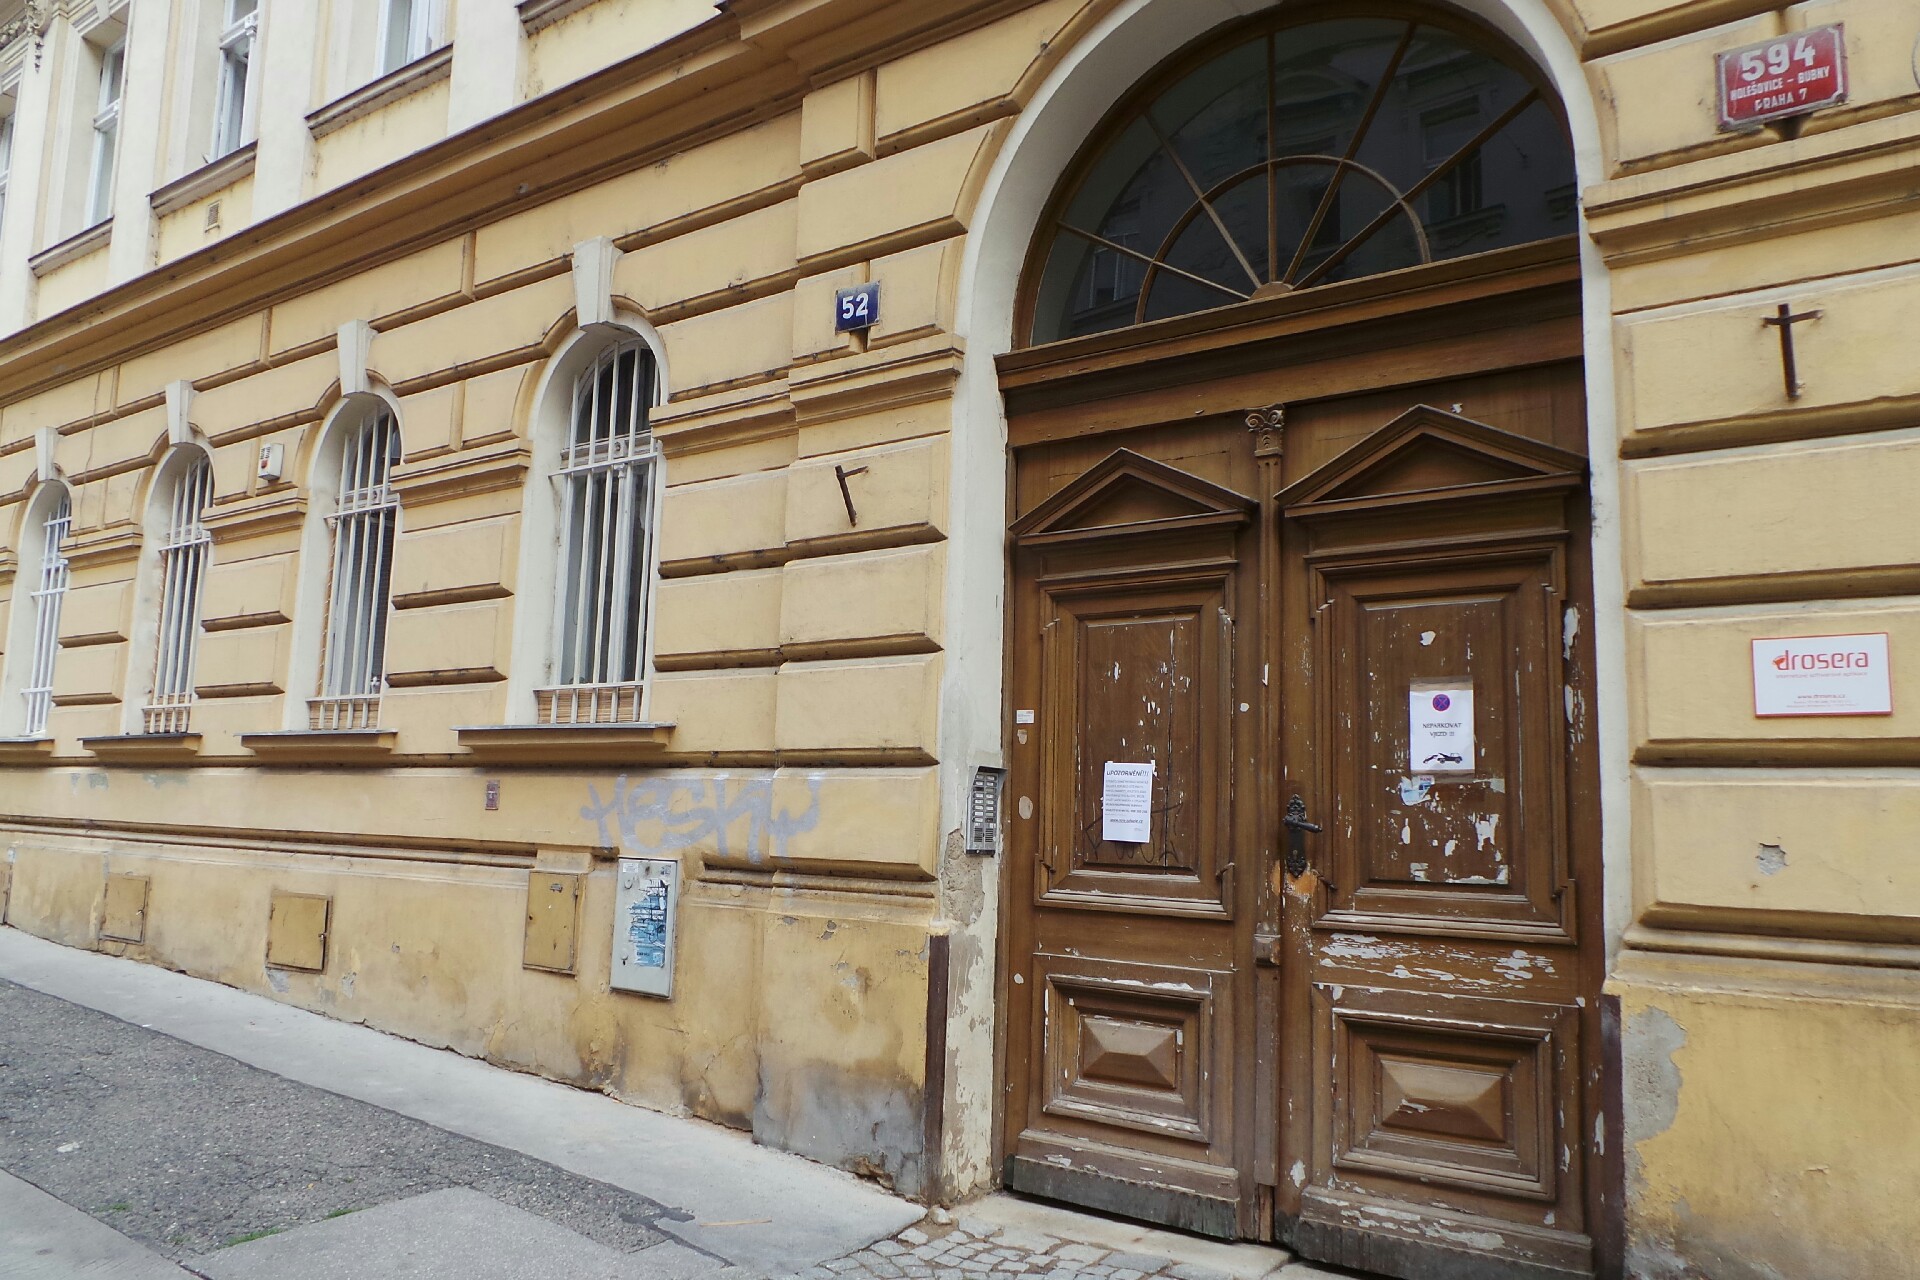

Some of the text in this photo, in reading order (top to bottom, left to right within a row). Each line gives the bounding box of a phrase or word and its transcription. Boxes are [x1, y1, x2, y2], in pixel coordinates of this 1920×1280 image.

[1741, 36, 1816, 82] 594
[1730, 81, 1784, 101] HOLEŠOVICE
[1798, 65, 1830, 84] BUBNY
[1754, 88, 1808, 113] PRAHA 7
[842, 292, 869, 319] 52
[1773, 649, 1869, 671] drosera
